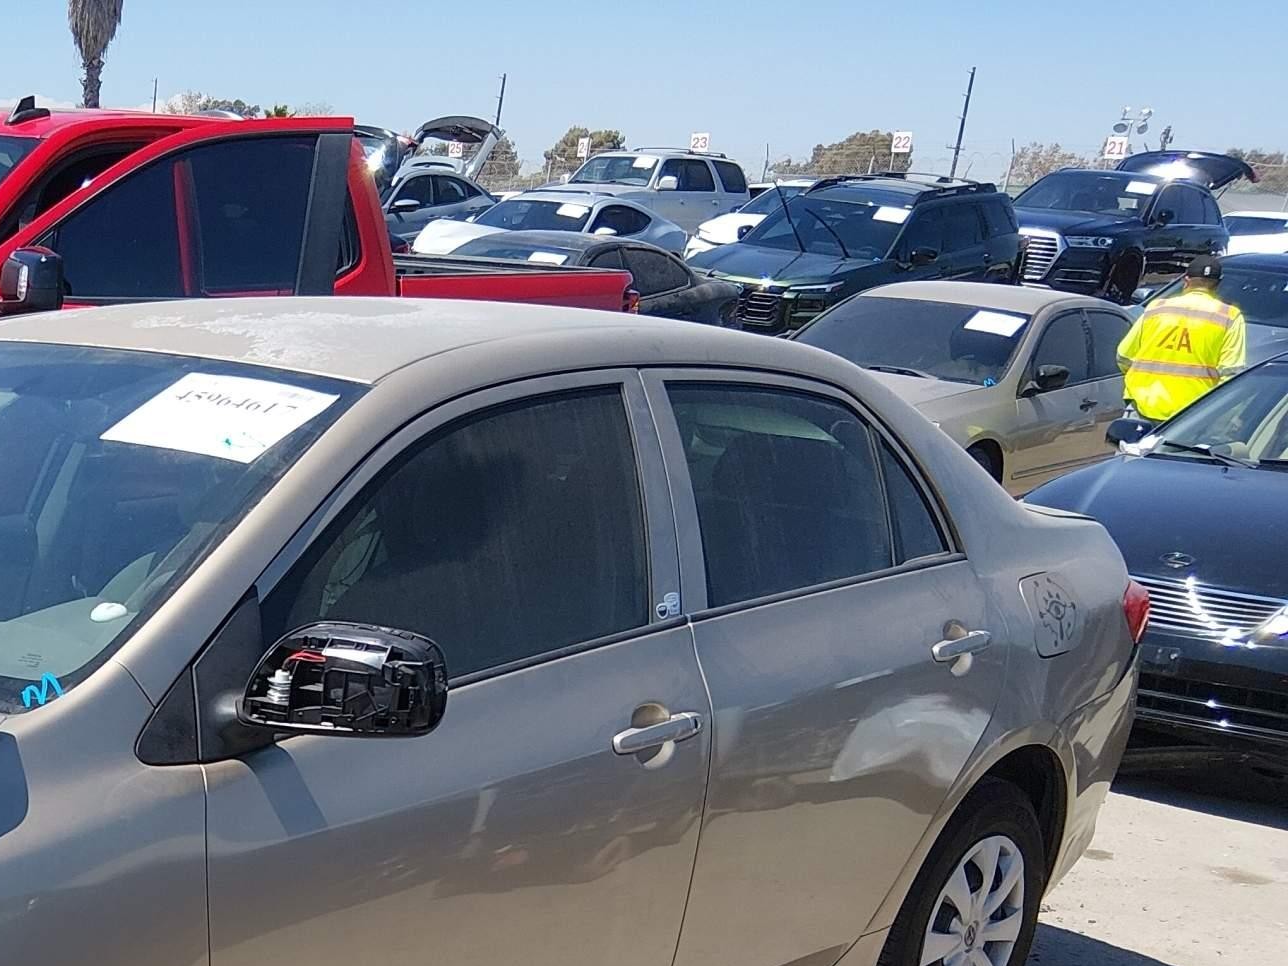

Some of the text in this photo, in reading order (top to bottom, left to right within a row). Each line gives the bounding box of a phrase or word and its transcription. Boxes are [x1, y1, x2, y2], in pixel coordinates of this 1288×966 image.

[450, 143, 462, 154] 25
[578, 142, 589, 154] 2
[692, 136, 708, 149] 23
[893, 135, 911, 149] 22
[1106, 140, 1124, 155] 21
[21, 671, 65, 708] M
